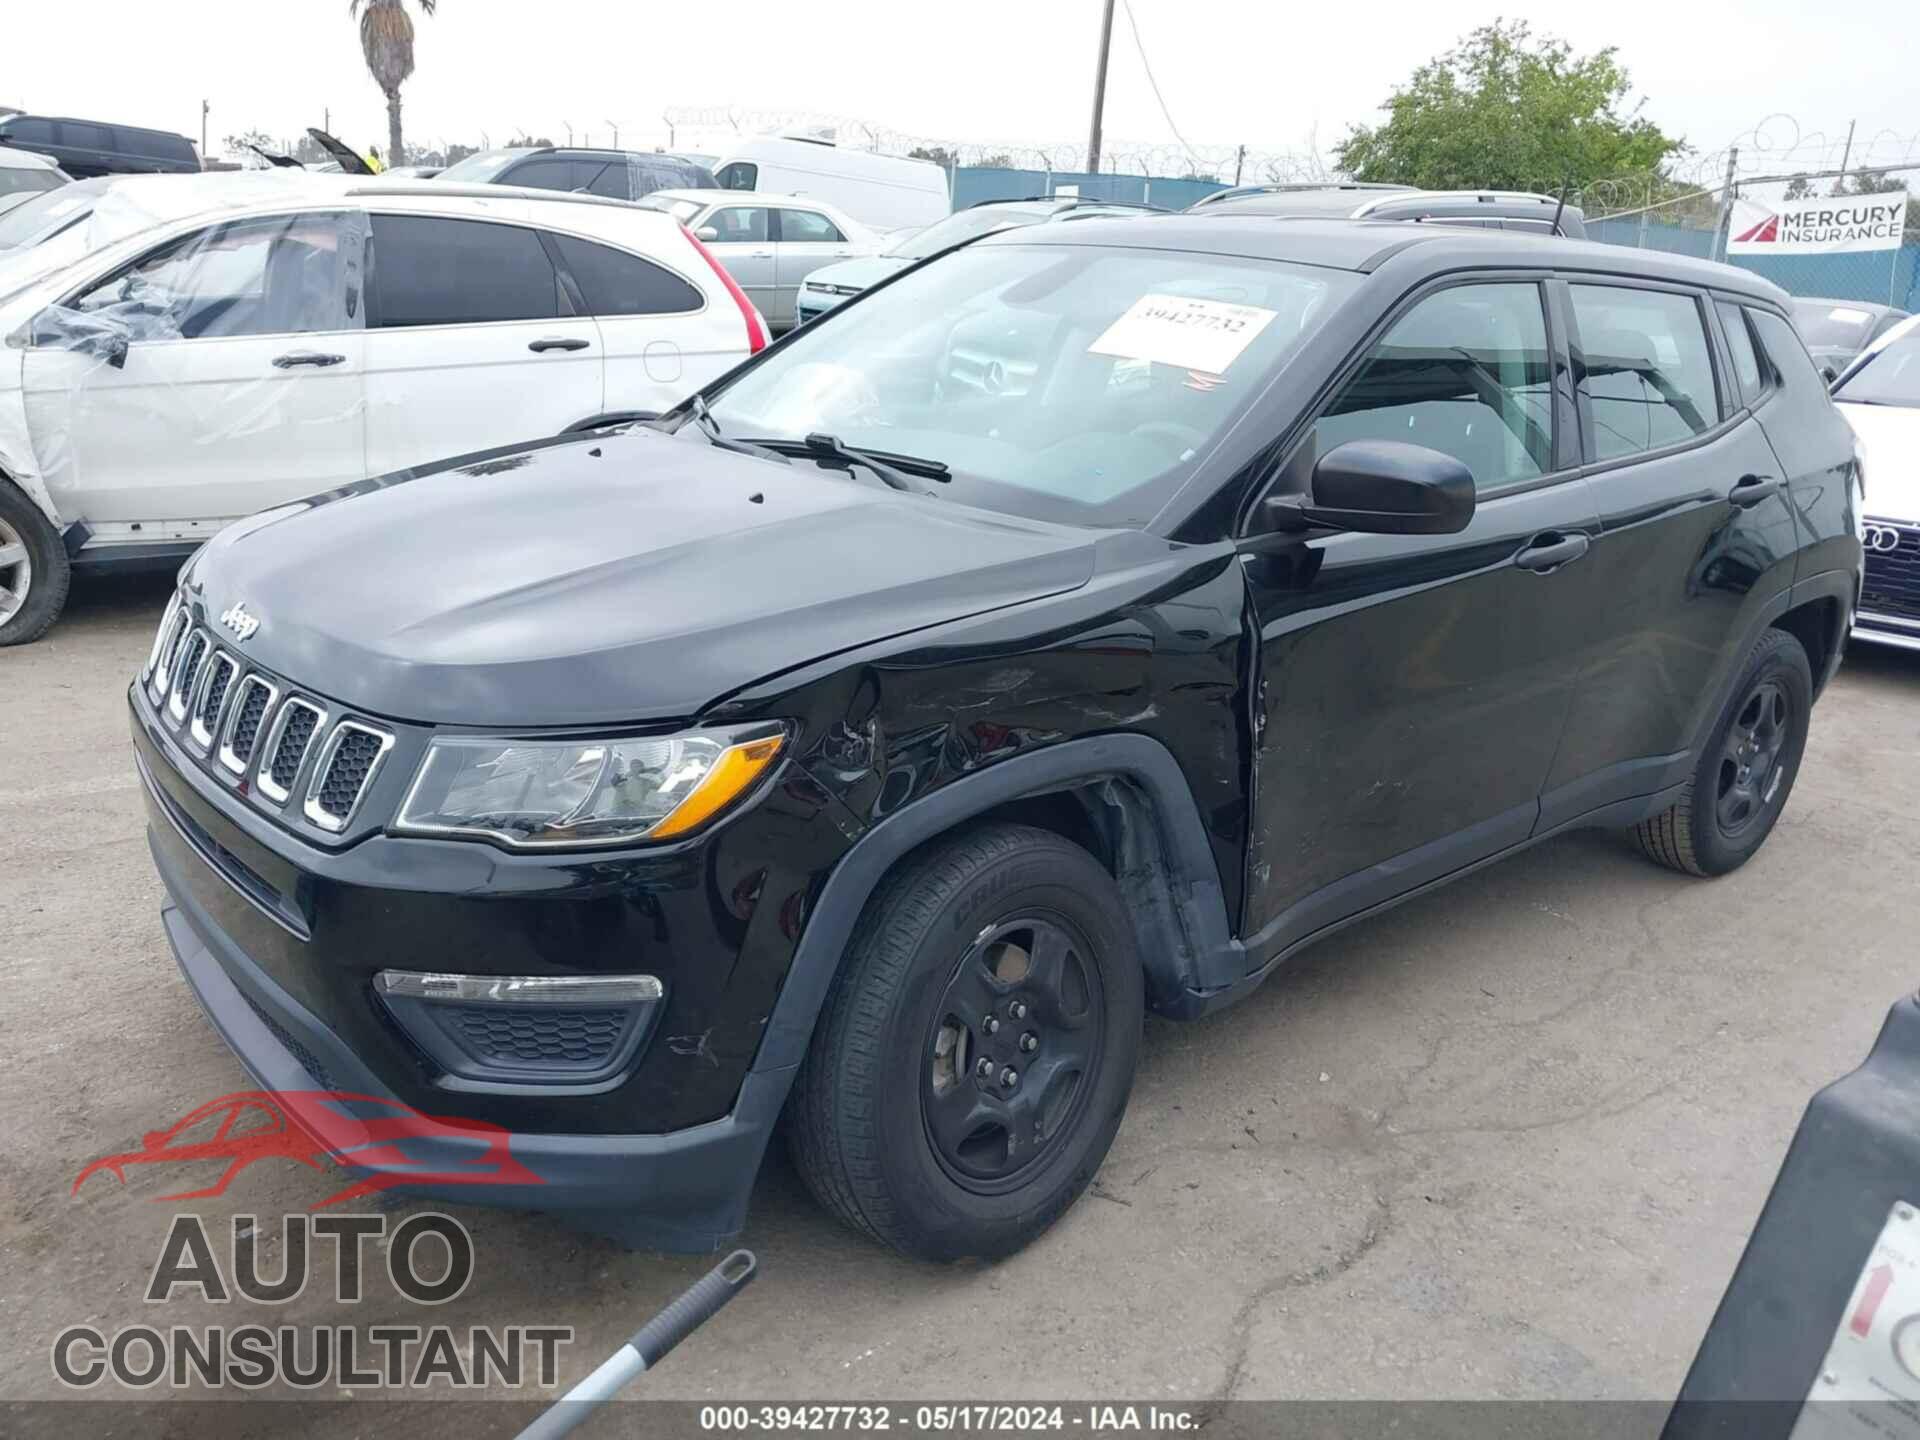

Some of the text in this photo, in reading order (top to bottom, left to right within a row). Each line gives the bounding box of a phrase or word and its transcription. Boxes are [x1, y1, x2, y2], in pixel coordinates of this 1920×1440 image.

[1783, 203, 1902, 228] MERCURY
[1782, 222, 1900, 243] INSURANCE
[221, 601, 260, 641] Jeep
